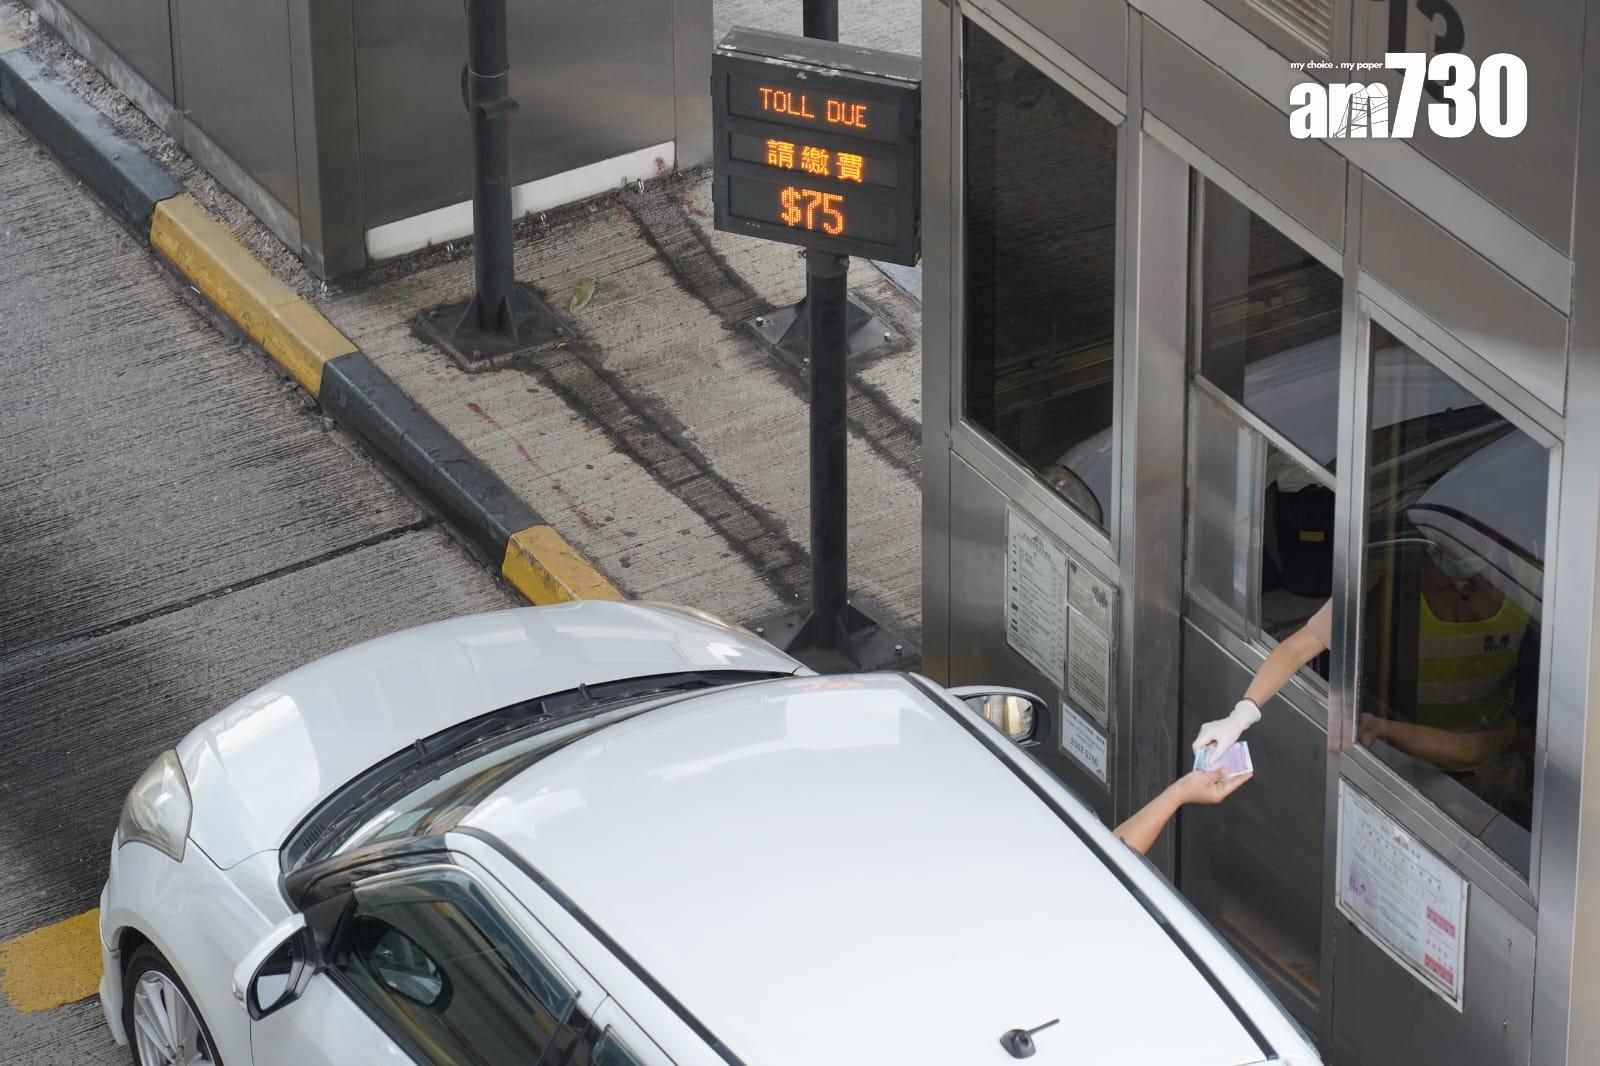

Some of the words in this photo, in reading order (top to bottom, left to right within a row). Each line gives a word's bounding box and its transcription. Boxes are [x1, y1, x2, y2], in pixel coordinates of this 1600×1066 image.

[759, 87, 815, 118] TOLL
[827, 99, 867, 128] DUE
[767, 139, 863, 182] 請繳費
[781, 186, 844, 235] $75
